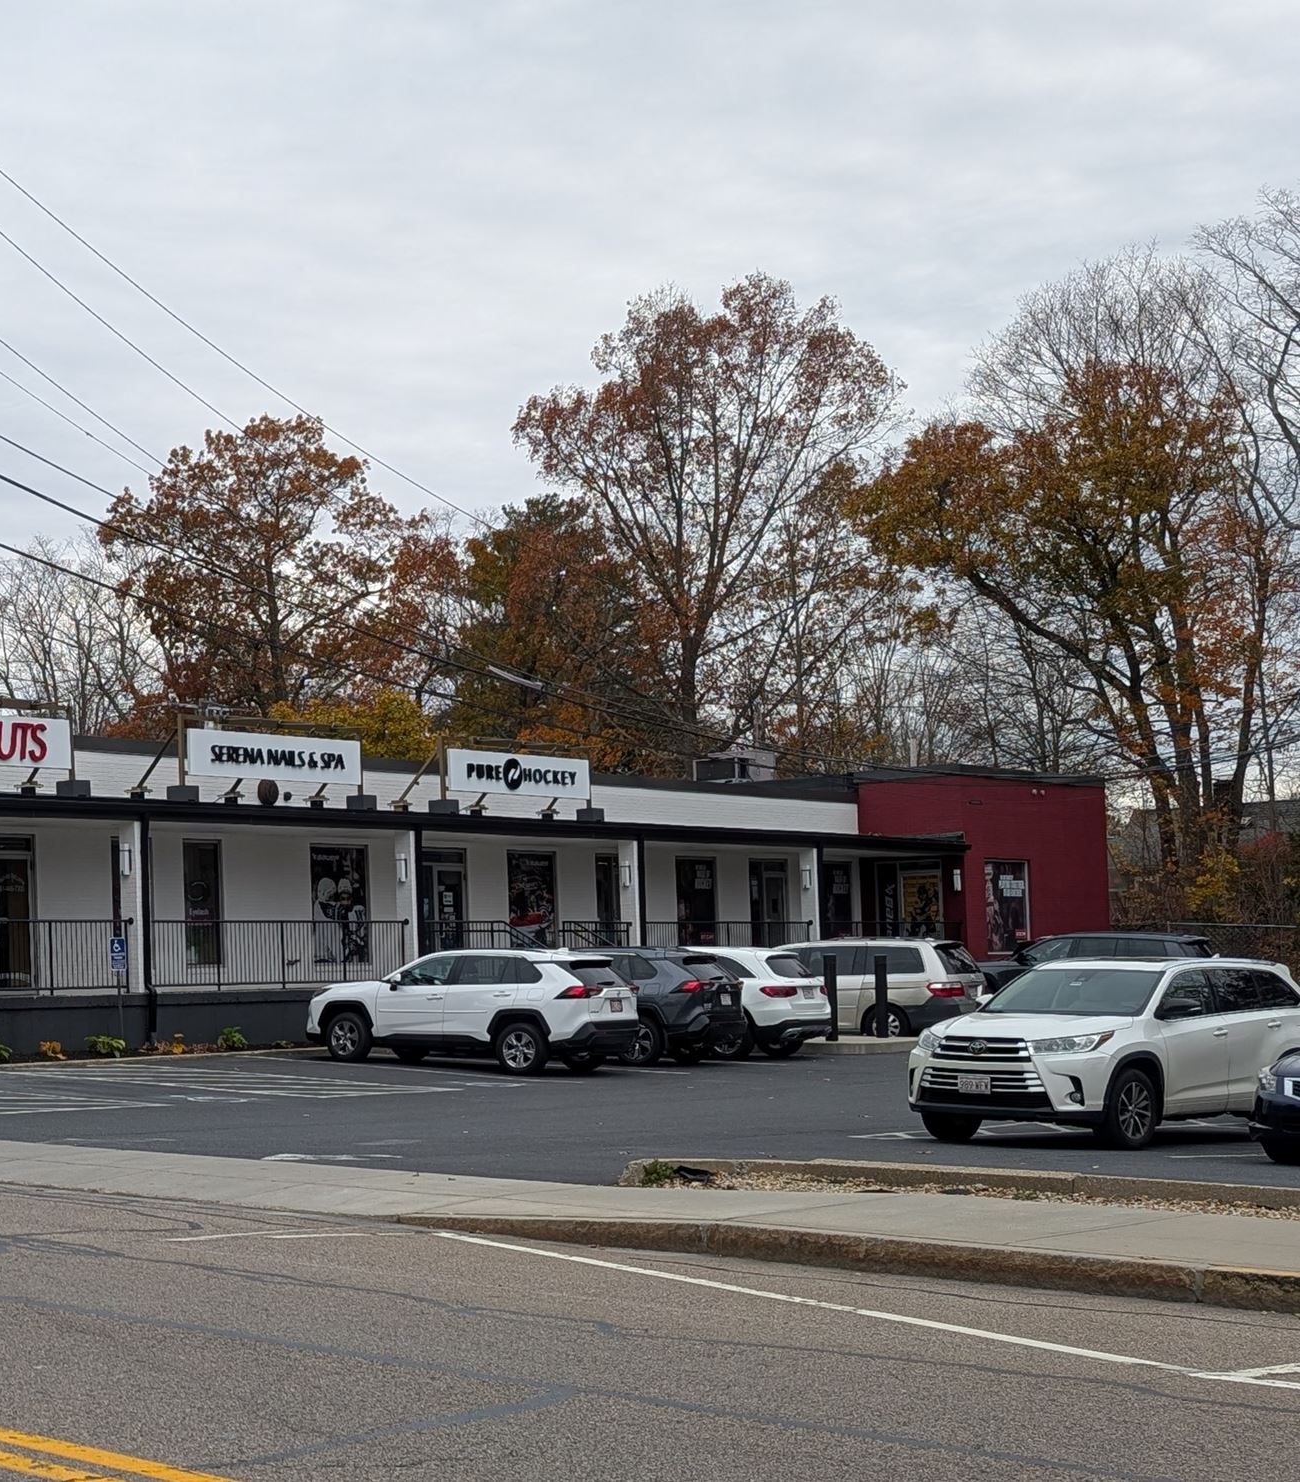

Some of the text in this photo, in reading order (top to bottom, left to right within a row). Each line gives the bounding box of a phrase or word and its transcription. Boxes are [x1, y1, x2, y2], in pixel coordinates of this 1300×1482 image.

[210, 744, 346, 770] SERENA NAILS & SPA
[466, 763, 577, 786] PURE HOCKEY
